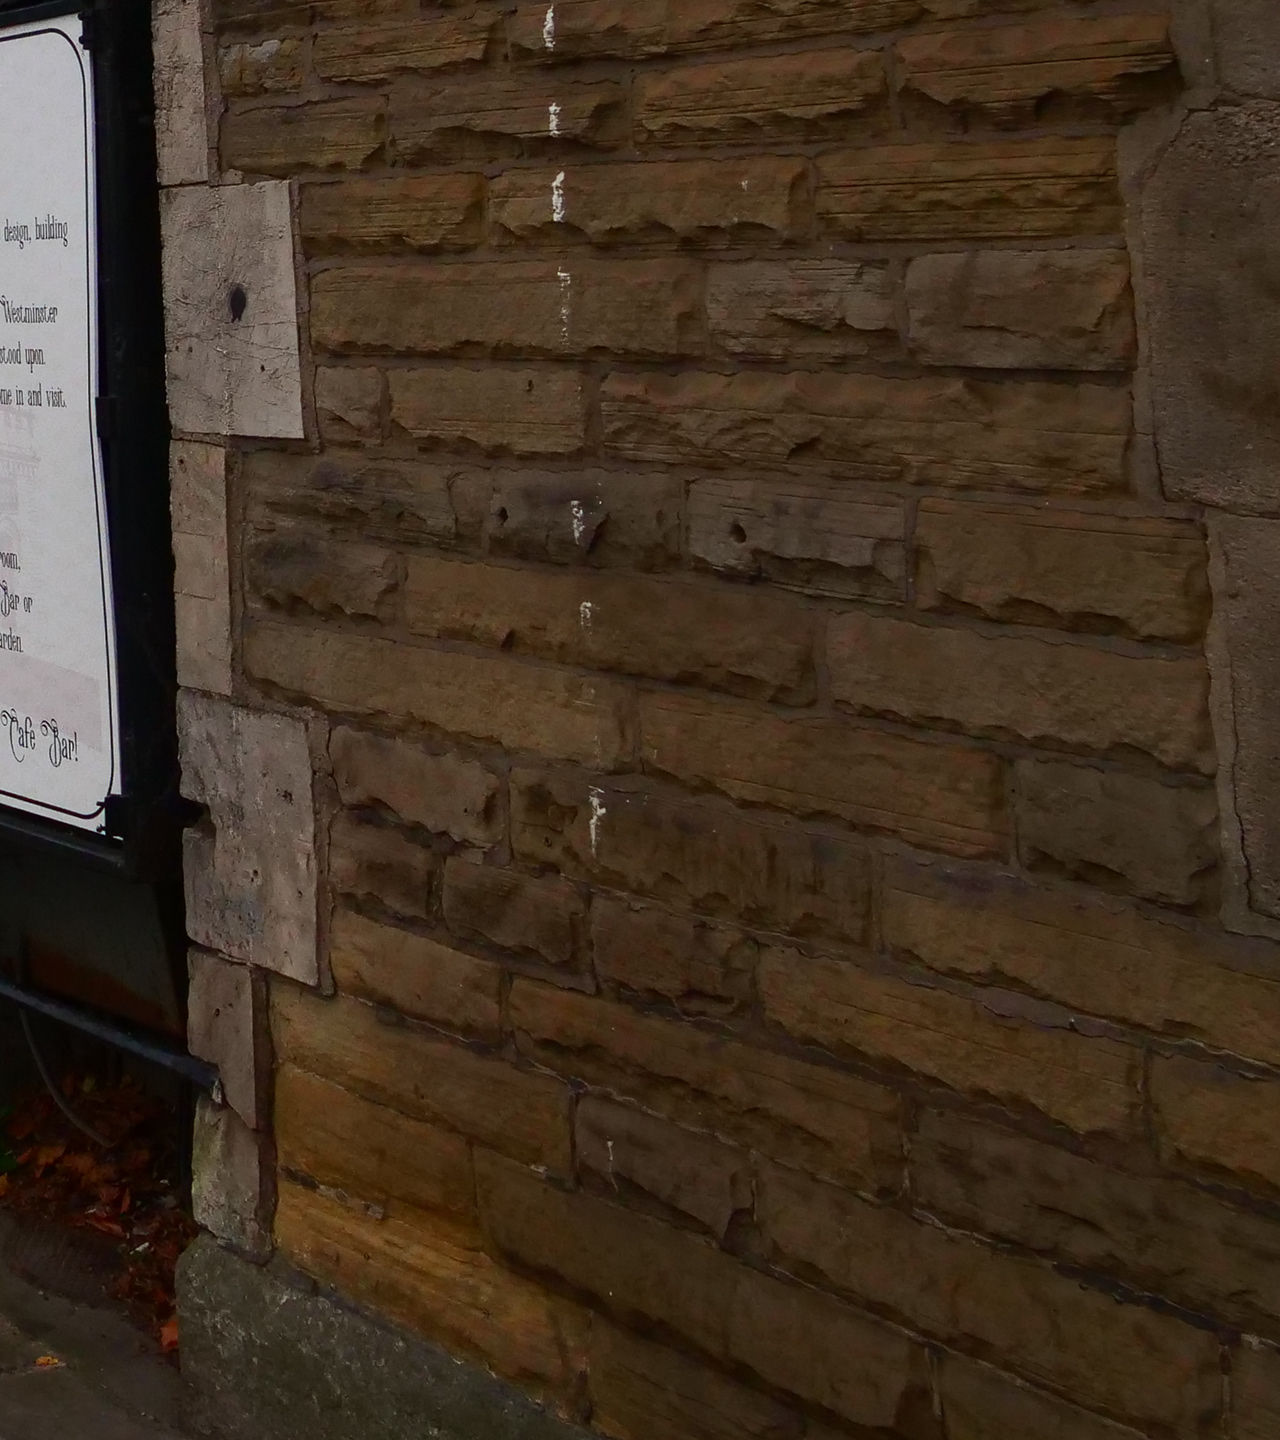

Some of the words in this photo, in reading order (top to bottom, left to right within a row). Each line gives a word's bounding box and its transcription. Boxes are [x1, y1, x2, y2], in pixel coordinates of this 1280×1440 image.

[4, 219, 32, 250] design,
[35, 213, 68, 247] building
[0, 341, 21, 364] stood
[15, 385, 24, 406] in
[27, 383, 42, 406] and
[23, 596, 33, 613] or
[1, 708, 36, 763] Cafe
[40, 718, 78, 768] Bar!
